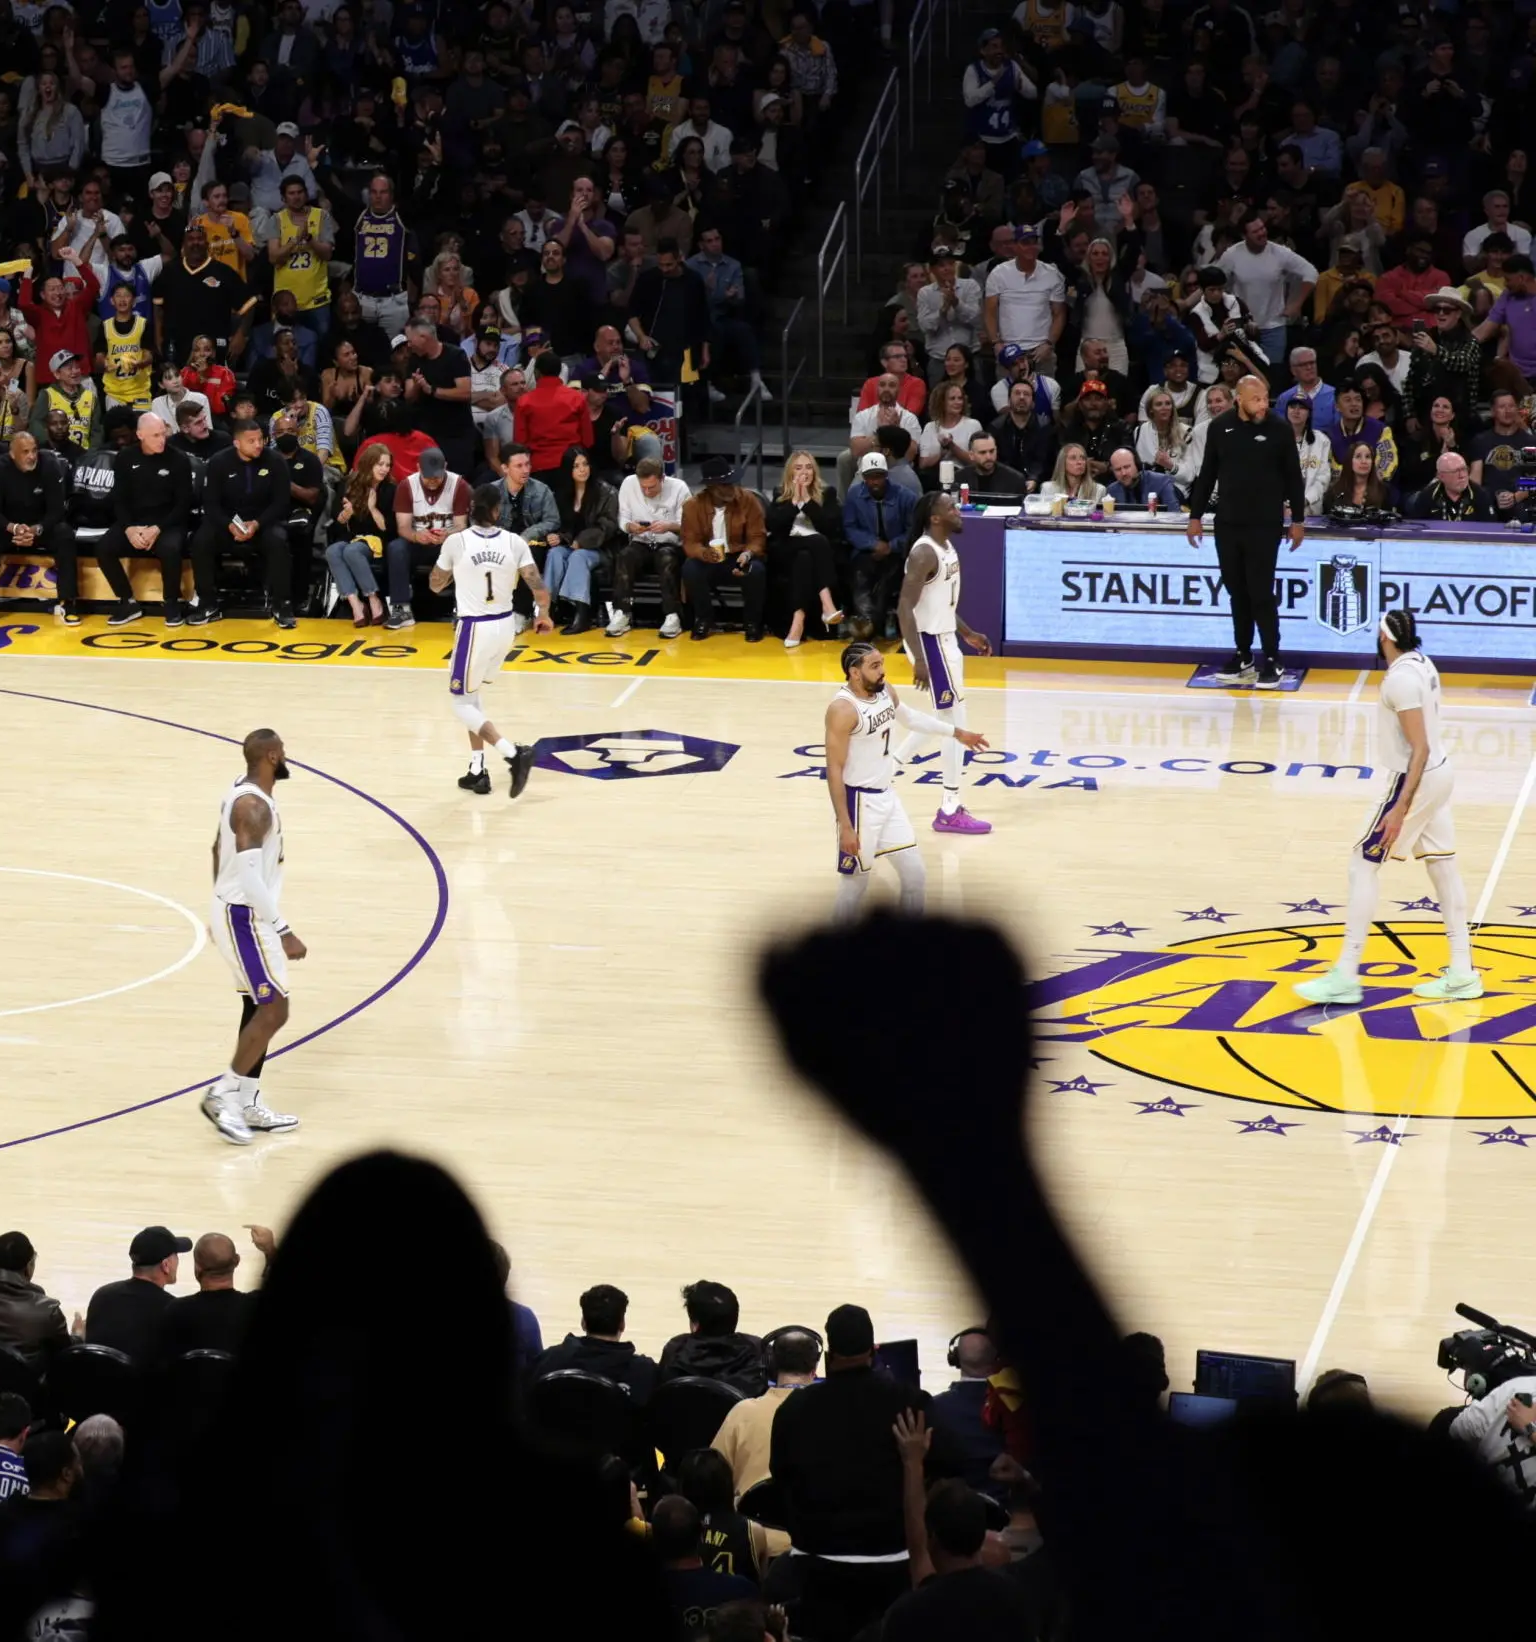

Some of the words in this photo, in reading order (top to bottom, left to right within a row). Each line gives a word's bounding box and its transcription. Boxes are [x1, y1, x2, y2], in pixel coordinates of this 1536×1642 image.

[290, 251, 312, 268] 23
[363, 236, 389, 258] 23
[82, 466, 115, 487] PLAYO
[470, 551, 506, 566] RUSSELL
[485, 571, 494, 602] 1
[1061, 570, 1224, 607] STANLEY
[1379, 581, 1536, 617] PLAYOF
[80, 631, 418, 661] Google
[443, 642, 661, 668] ixel
[866, 705, 895, 735] LAKERS
[881, 727, 890, 756] 7
[793, 743, 1375, 780] cypto.com
[776, 765, 1099, 791] AENA
[1, 1460, 25, 1473] OF
